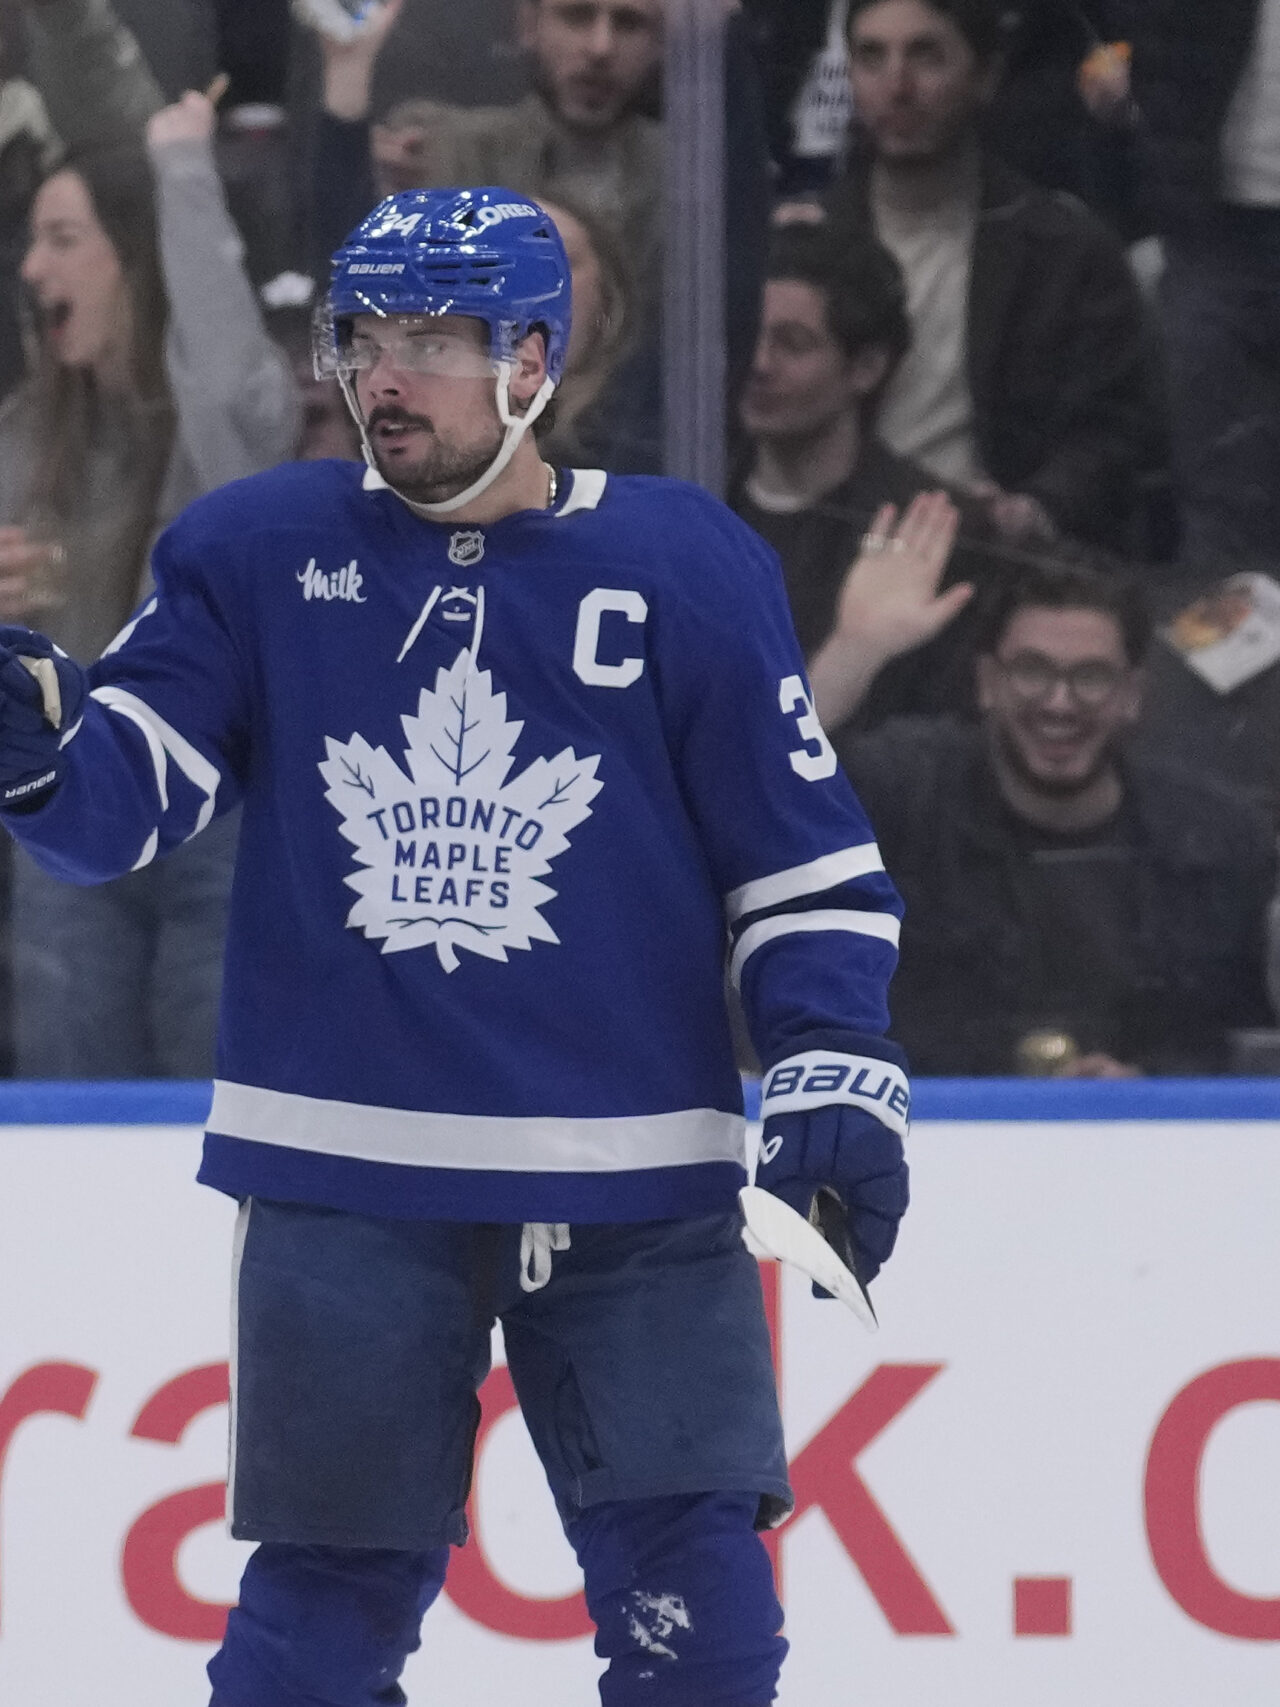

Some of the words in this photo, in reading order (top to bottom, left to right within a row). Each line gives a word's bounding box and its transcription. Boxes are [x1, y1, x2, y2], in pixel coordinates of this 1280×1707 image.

[477, 203, 538, 226] OREO
[347, 263, 405, 275] BAUER
[297, 557, 368, 603] Milk
[573, 587, 648, 689] C
[366, 796, 544, 850] TORONTO
[394, 839, 512, 873] MAPLE
[391, 873, 509, 908] LEAFS
[765, 1064, 911, 1124] BAUE
